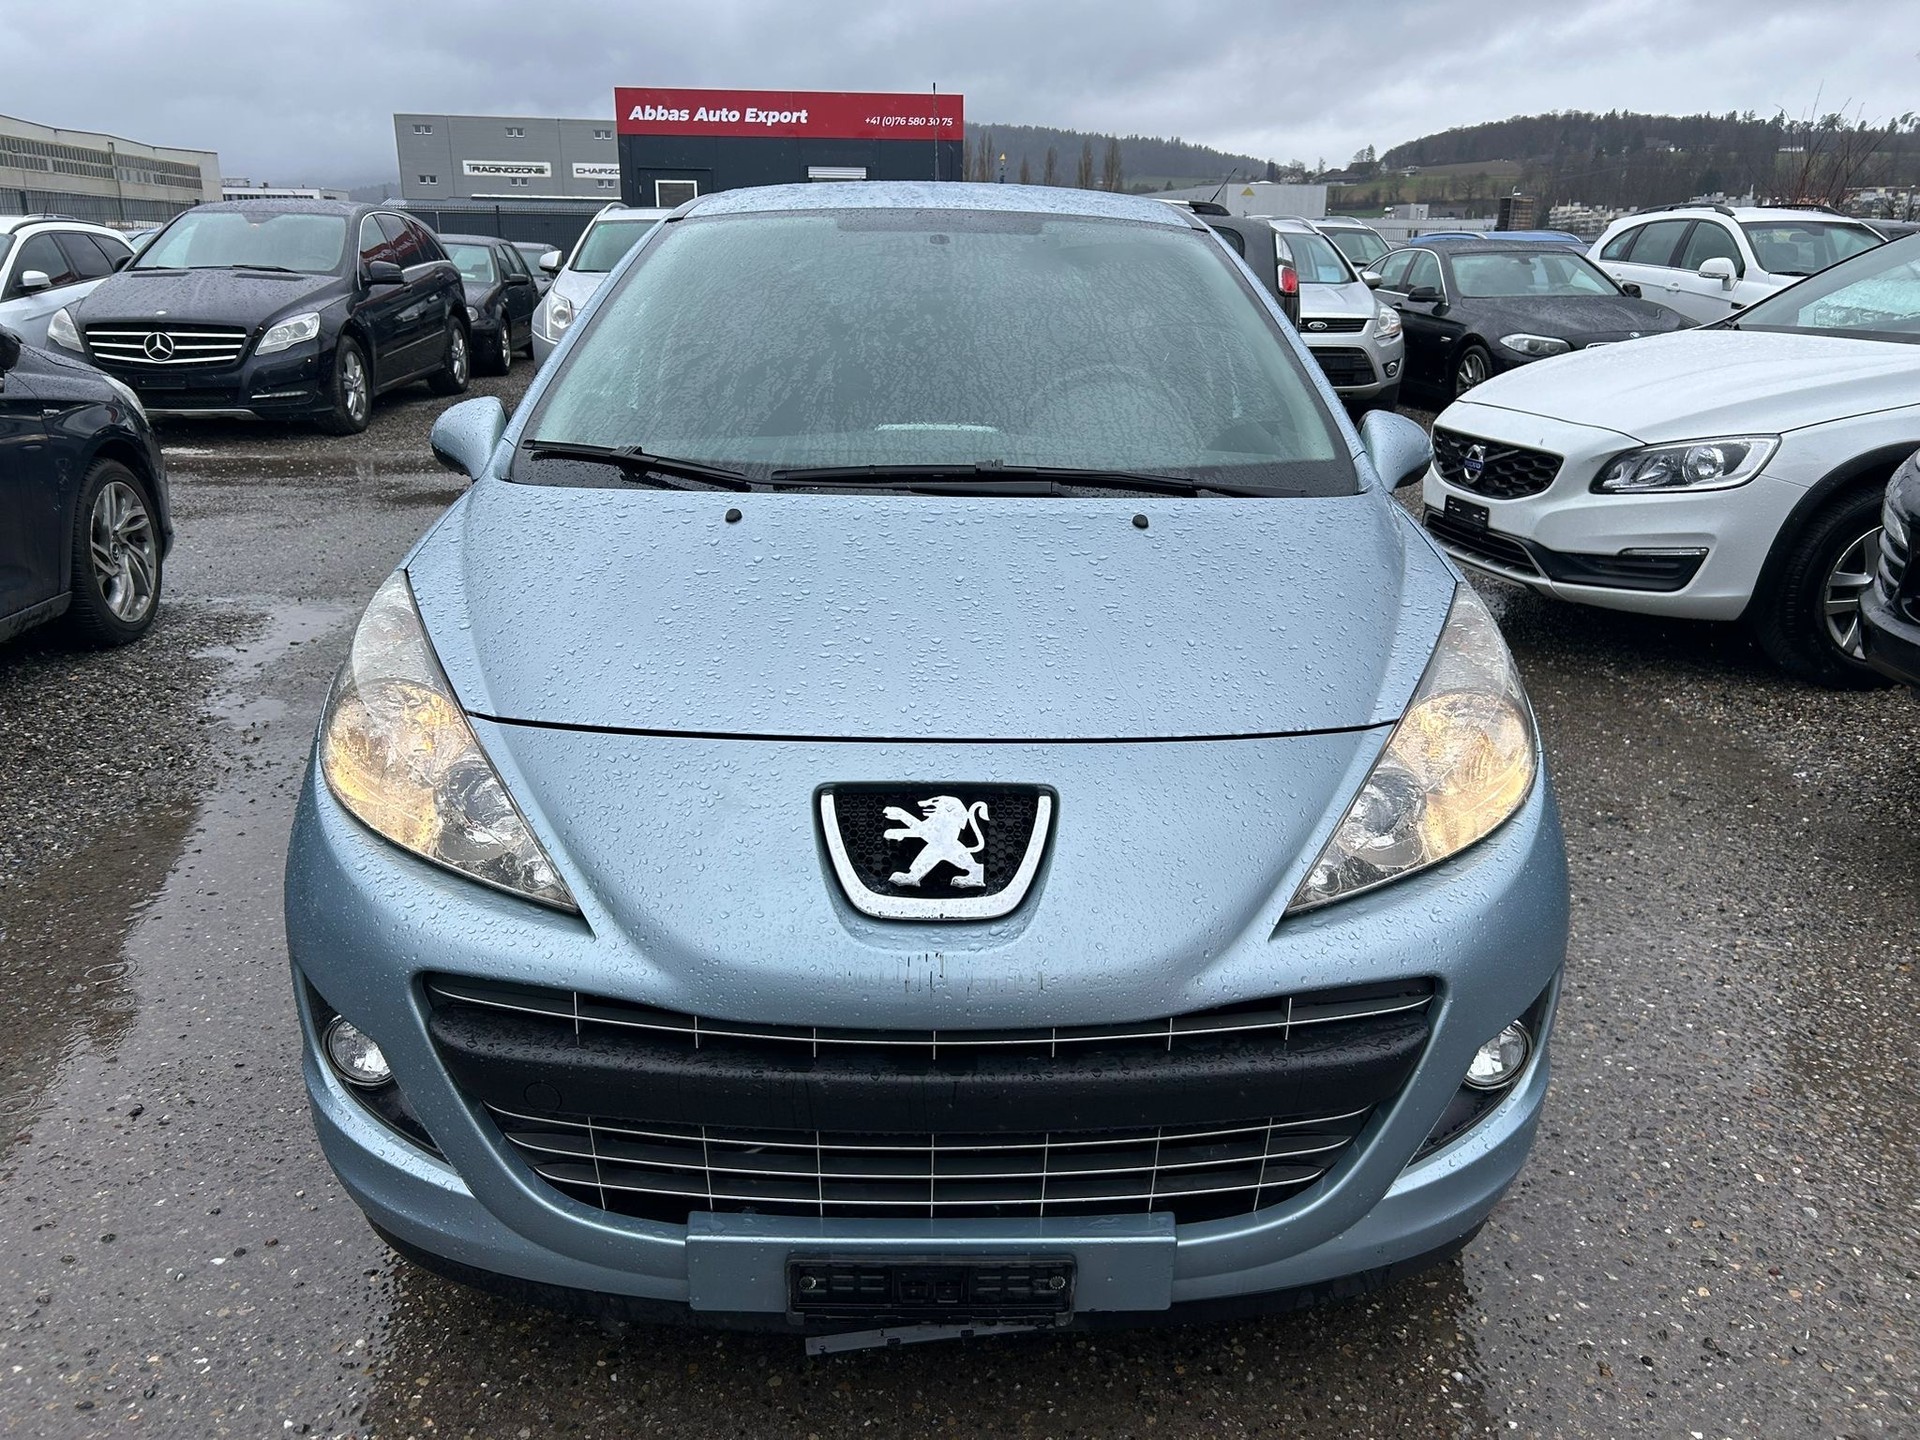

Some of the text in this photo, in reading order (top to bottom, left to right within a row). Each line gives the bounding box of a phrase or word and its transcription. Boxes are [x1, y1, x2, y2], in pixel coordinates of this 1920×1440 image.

[629, 106, 808, 126] Abbas Auto Export
[865, 116, 953, 127] +41 (0)76 580 30 75
